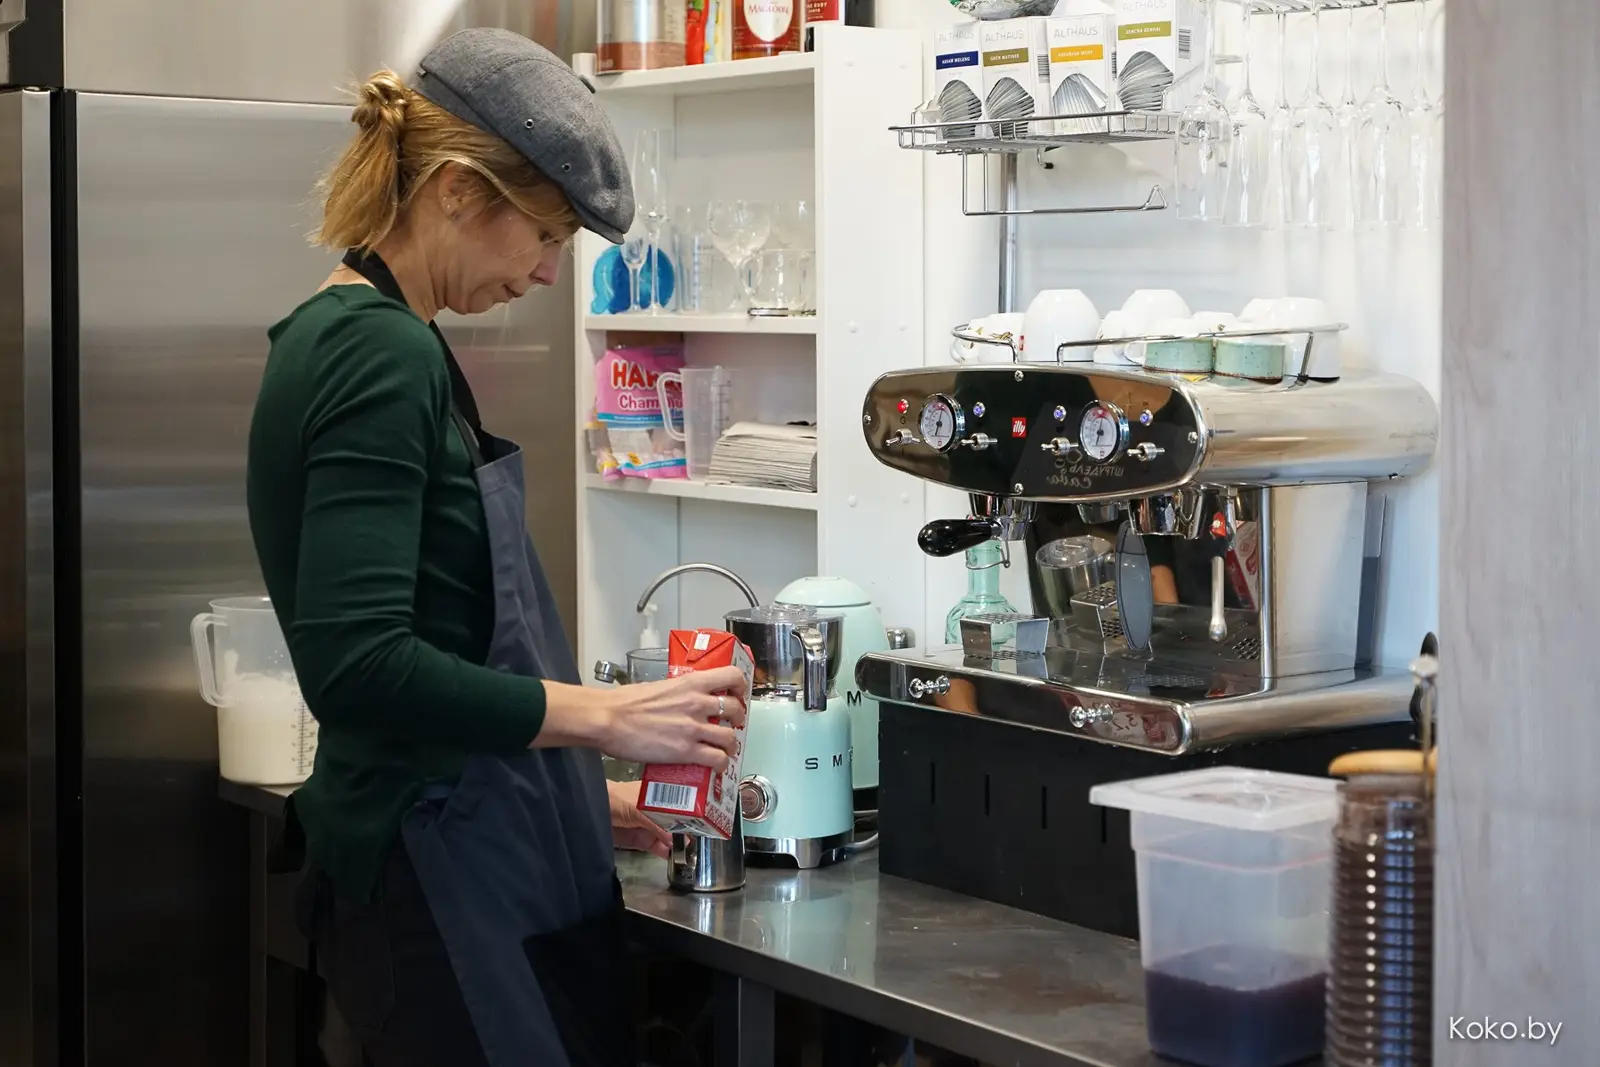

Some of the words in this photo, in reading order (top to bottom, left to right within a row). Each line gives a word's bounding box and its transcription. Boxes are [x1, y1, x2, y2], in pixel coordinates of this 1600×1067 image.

[939, 30, 975, 42] ALTHAUS
[985, 30, 1025, 42] ALTHAUS
[1053, 26, 1099, 39] ALTHAUS
[1012, 420, 1026, 436] illy
